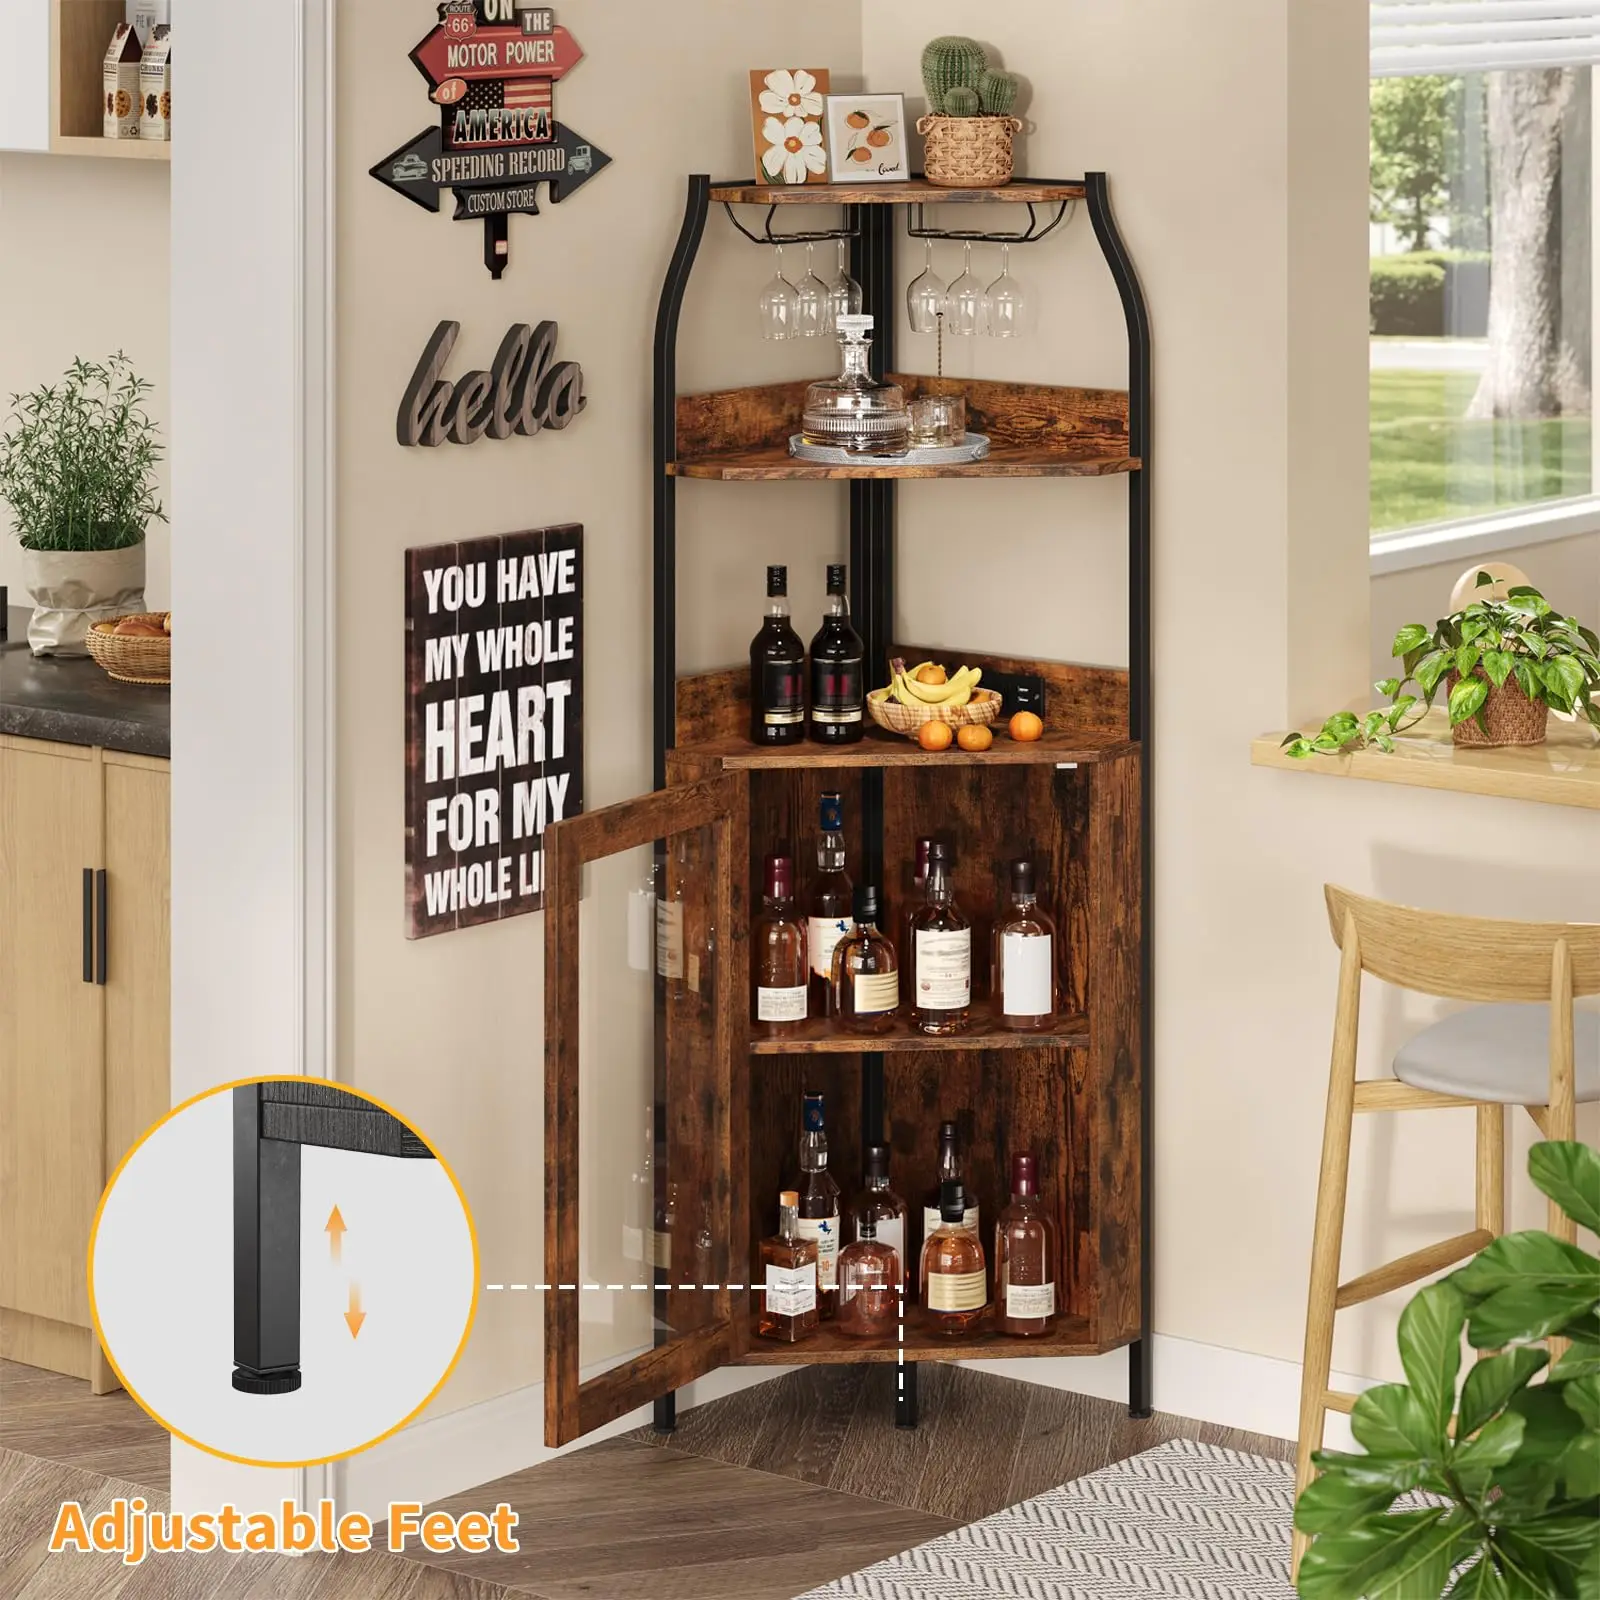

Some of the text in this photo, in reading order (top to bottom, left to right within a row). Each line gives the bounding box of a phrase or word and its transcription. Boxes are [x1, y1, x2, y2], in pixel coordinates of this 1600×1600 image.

[449, 4, 471, 13] ROUTE
[452, 18, 469, 33] 66
[484, 0, 513, 21] ON
[524, 12, 550, 31] THE
[447, 40, 555, 68] MOTOR POWER
[442, 82, 457, 100] of
[452, 106, 550, 144] AMERICA
[431, 147, 566, 183] SPEEDING RECORD
[467, 188, 535, 213] CUSTOM STORE
[397, 320, 587, 447] hello
[422, 549, 576, 615] YOU HAVE
[424, 616, 574, 683] MY WHOLE
[425, 679, 572, 784] HEART
[426, 772, 571, 858] FOR MY
[423, 856, 512, 917] WHOLE
